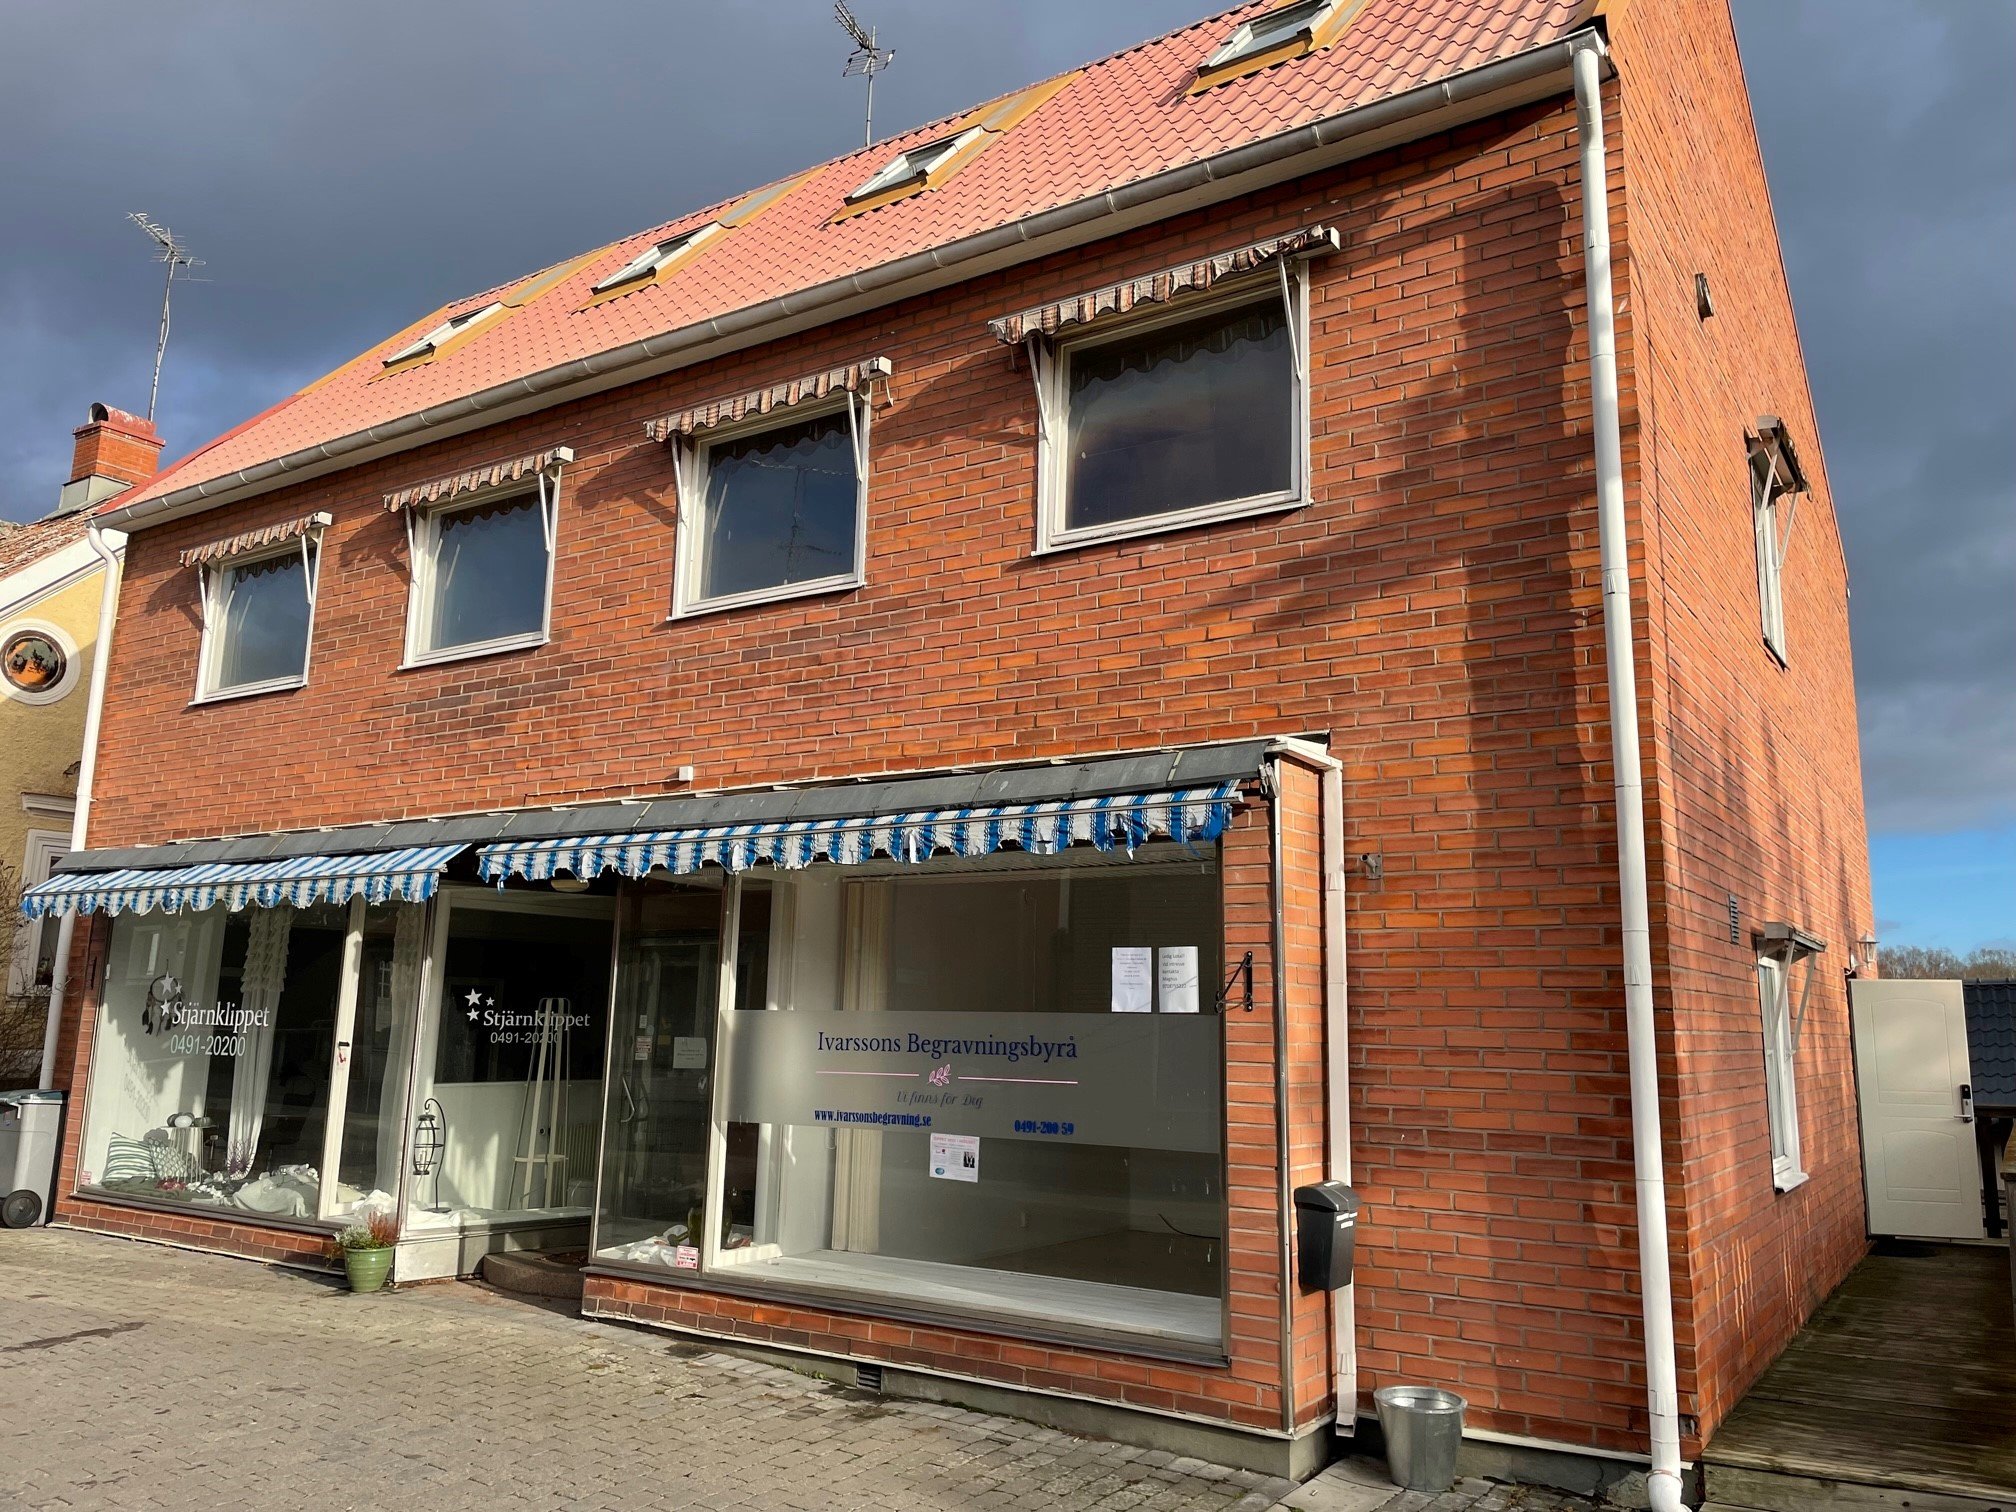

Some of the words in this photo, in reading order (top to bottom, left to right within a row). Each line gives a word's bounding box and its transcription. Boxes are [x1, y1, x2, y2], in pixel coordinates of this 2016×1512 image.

[172, 1001, 270, 1034] Stjärnklippet
[483, 1010, 590, 1031] Stjärnklippet
[170, 1034, 246, 1057] 0491-20200
[817, 1031, 901, 1053] Ivarssons
[907, 1032, 1078, 1063] Begravningsbyrå
[909, 1091, 938, 1106] finns
[814, 1109, 932, 1128] www.ivarssonsbegravning.se
[1014, 1119, 1059, 1136] 0491-200
